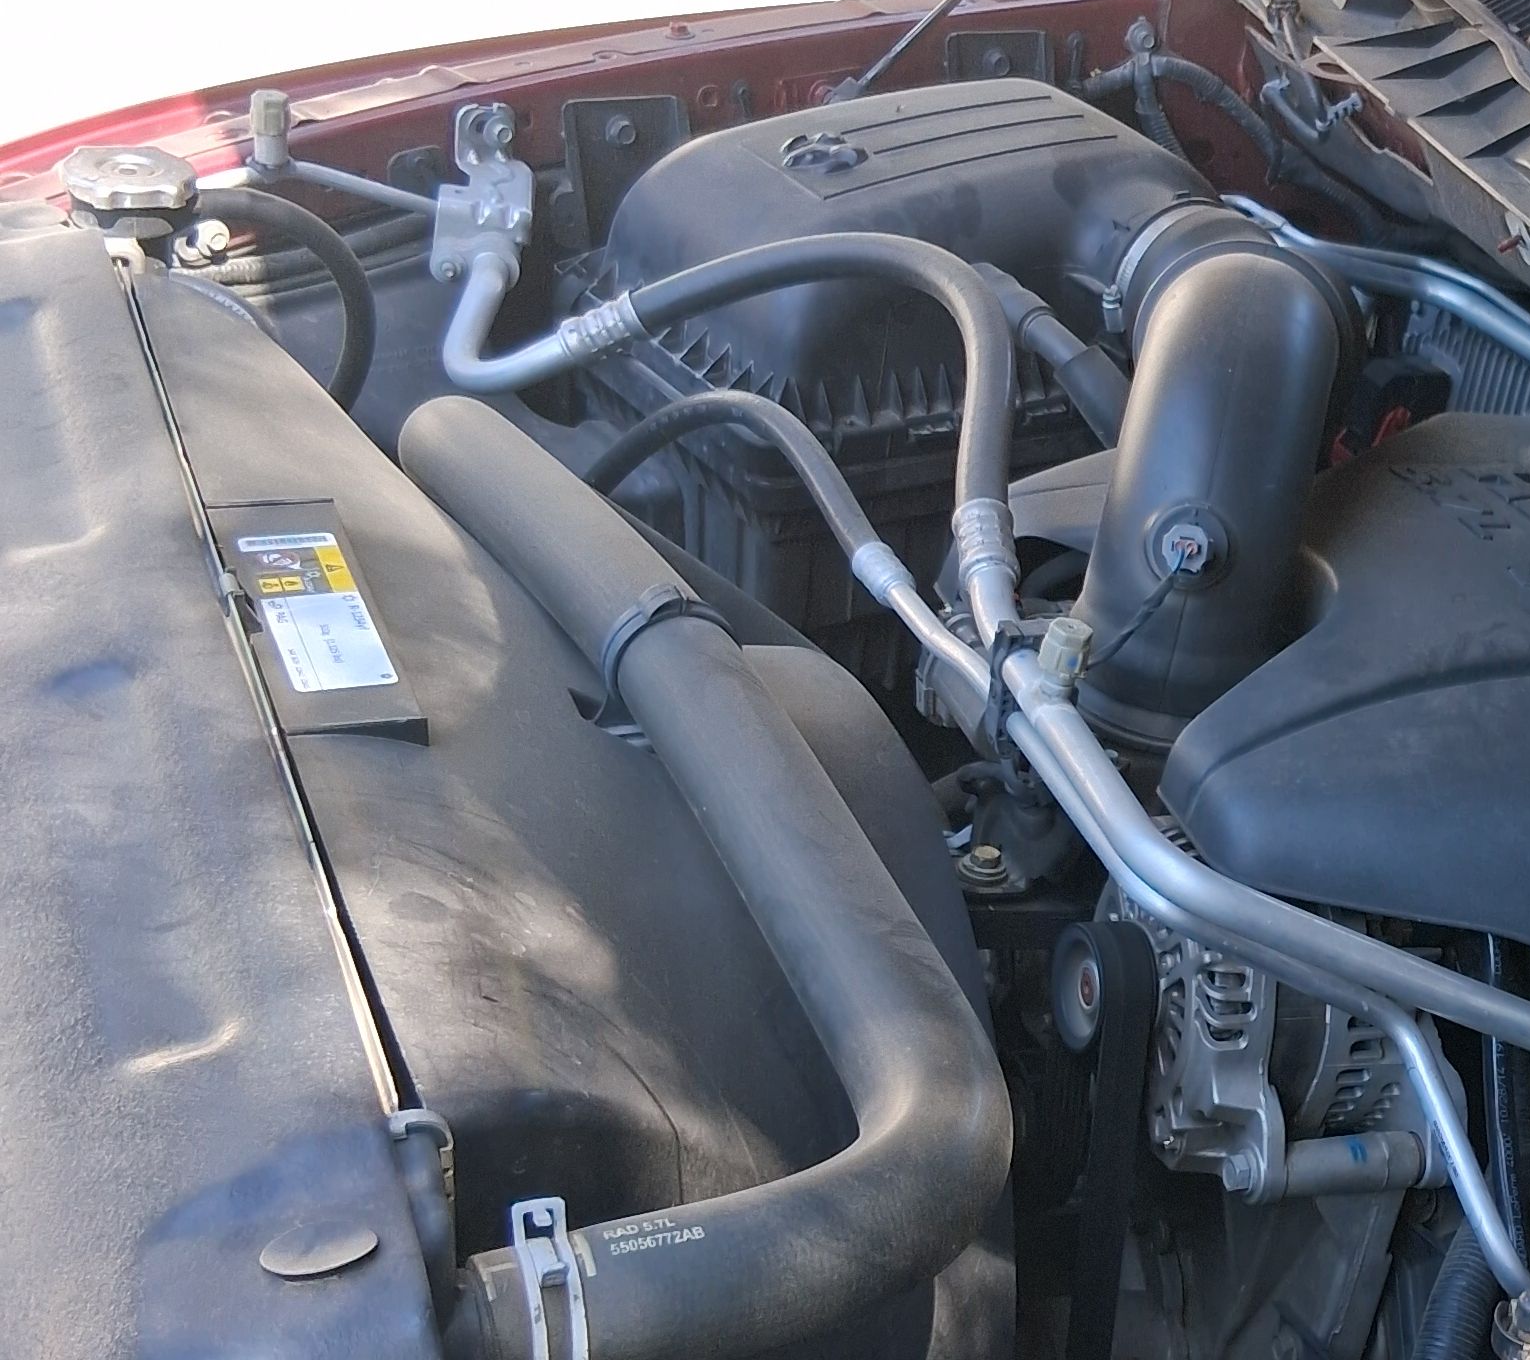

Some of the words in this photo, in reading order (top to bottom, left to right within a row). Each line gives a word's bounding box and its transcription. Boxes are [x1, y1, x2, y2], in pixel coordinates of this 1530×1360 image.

[602, 1223, 640, 1240] RAD
[642, 1218, 676, 1233] 5.7L
[610, 1225, 706, 1256] 55056772AB
